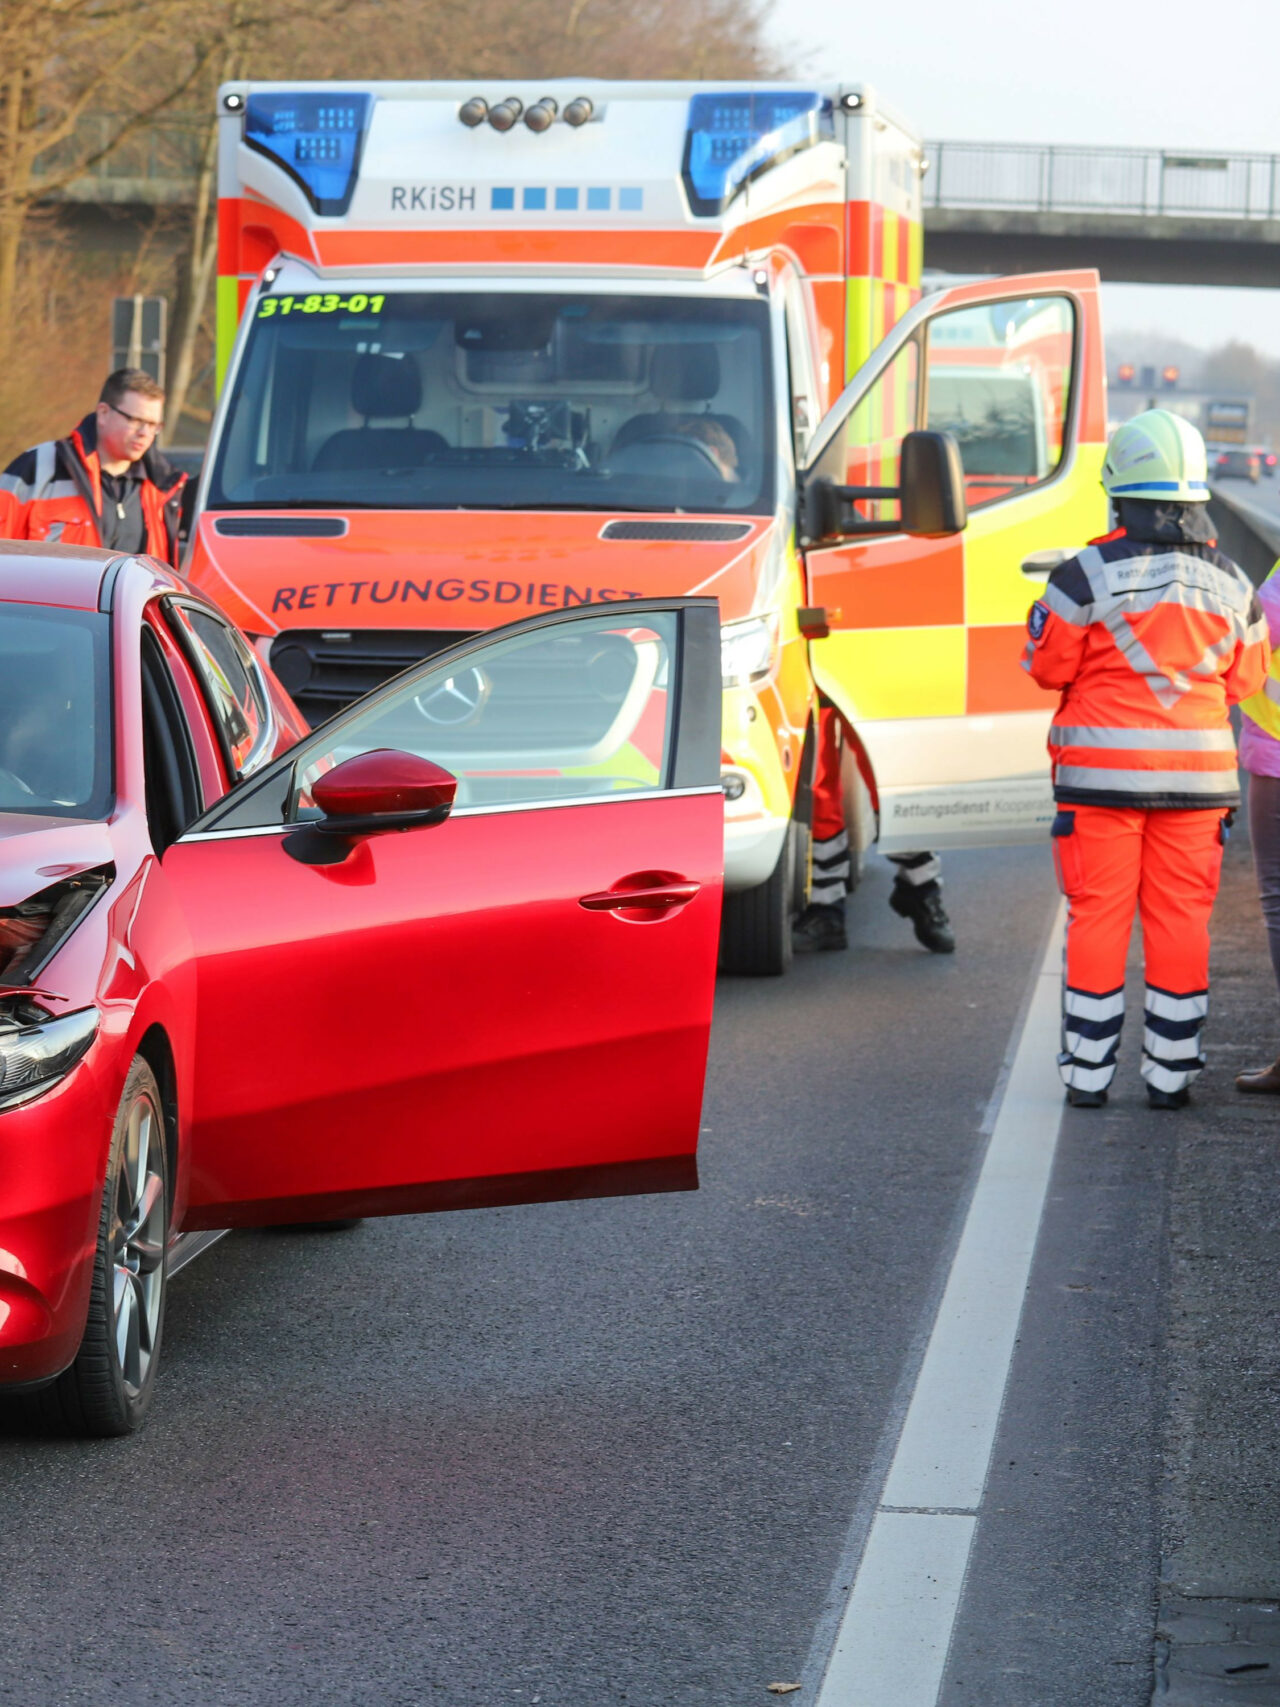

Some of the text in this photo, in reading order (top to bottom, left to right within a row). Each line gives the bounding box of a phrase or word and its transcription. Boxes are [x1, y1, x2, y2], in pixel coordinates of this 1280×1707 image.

[391, 186, 476, 211] RKiSH
[258, 294, 385, 318] 31-83-01
[893, 800, 991, 818] Rettungsdienst
